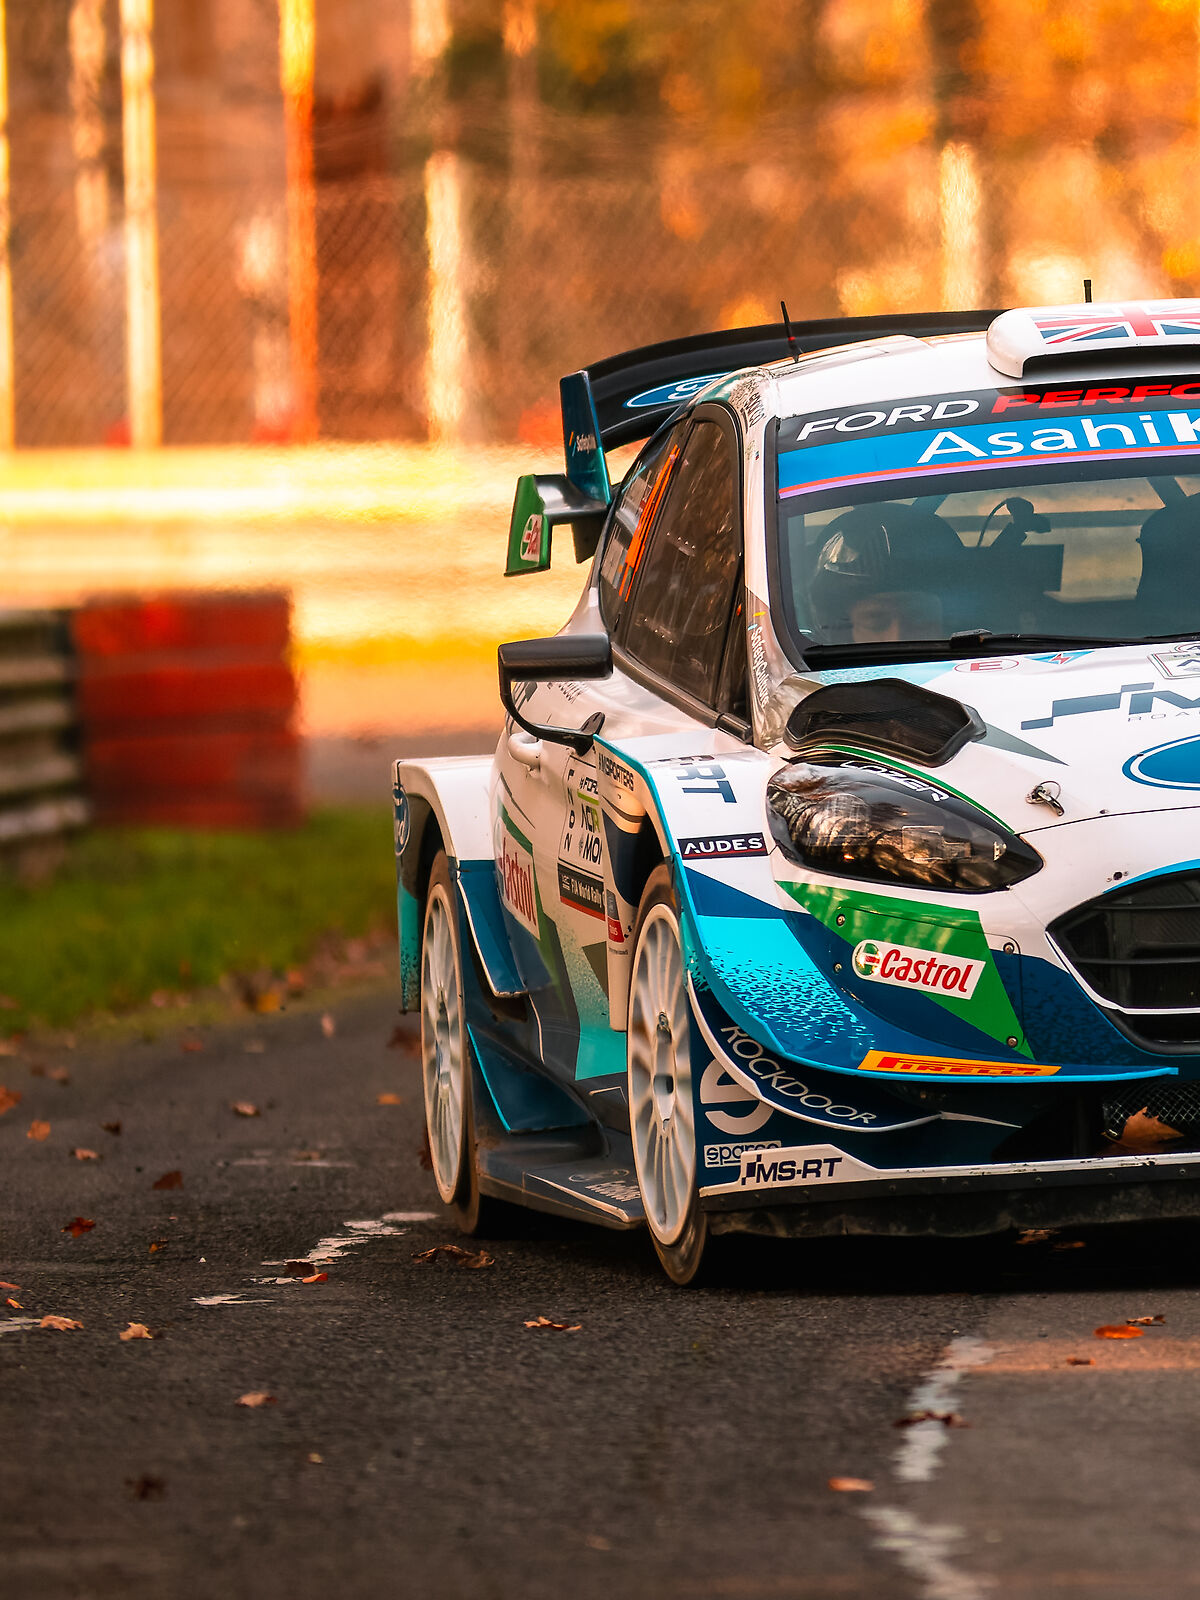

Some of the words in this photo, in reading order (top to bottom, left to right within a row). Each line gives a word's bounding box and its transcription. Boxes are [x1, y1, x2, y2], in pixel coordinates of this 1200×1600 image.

[796, 400, 980, 442] FORD
[684, 837, 763, 854] AUDES
[880, 949, 973, 993] Castrol
[720, 1025, 878, 1125] ROCKDOOR
[756, 1157, 843, 1183] MS-RT
